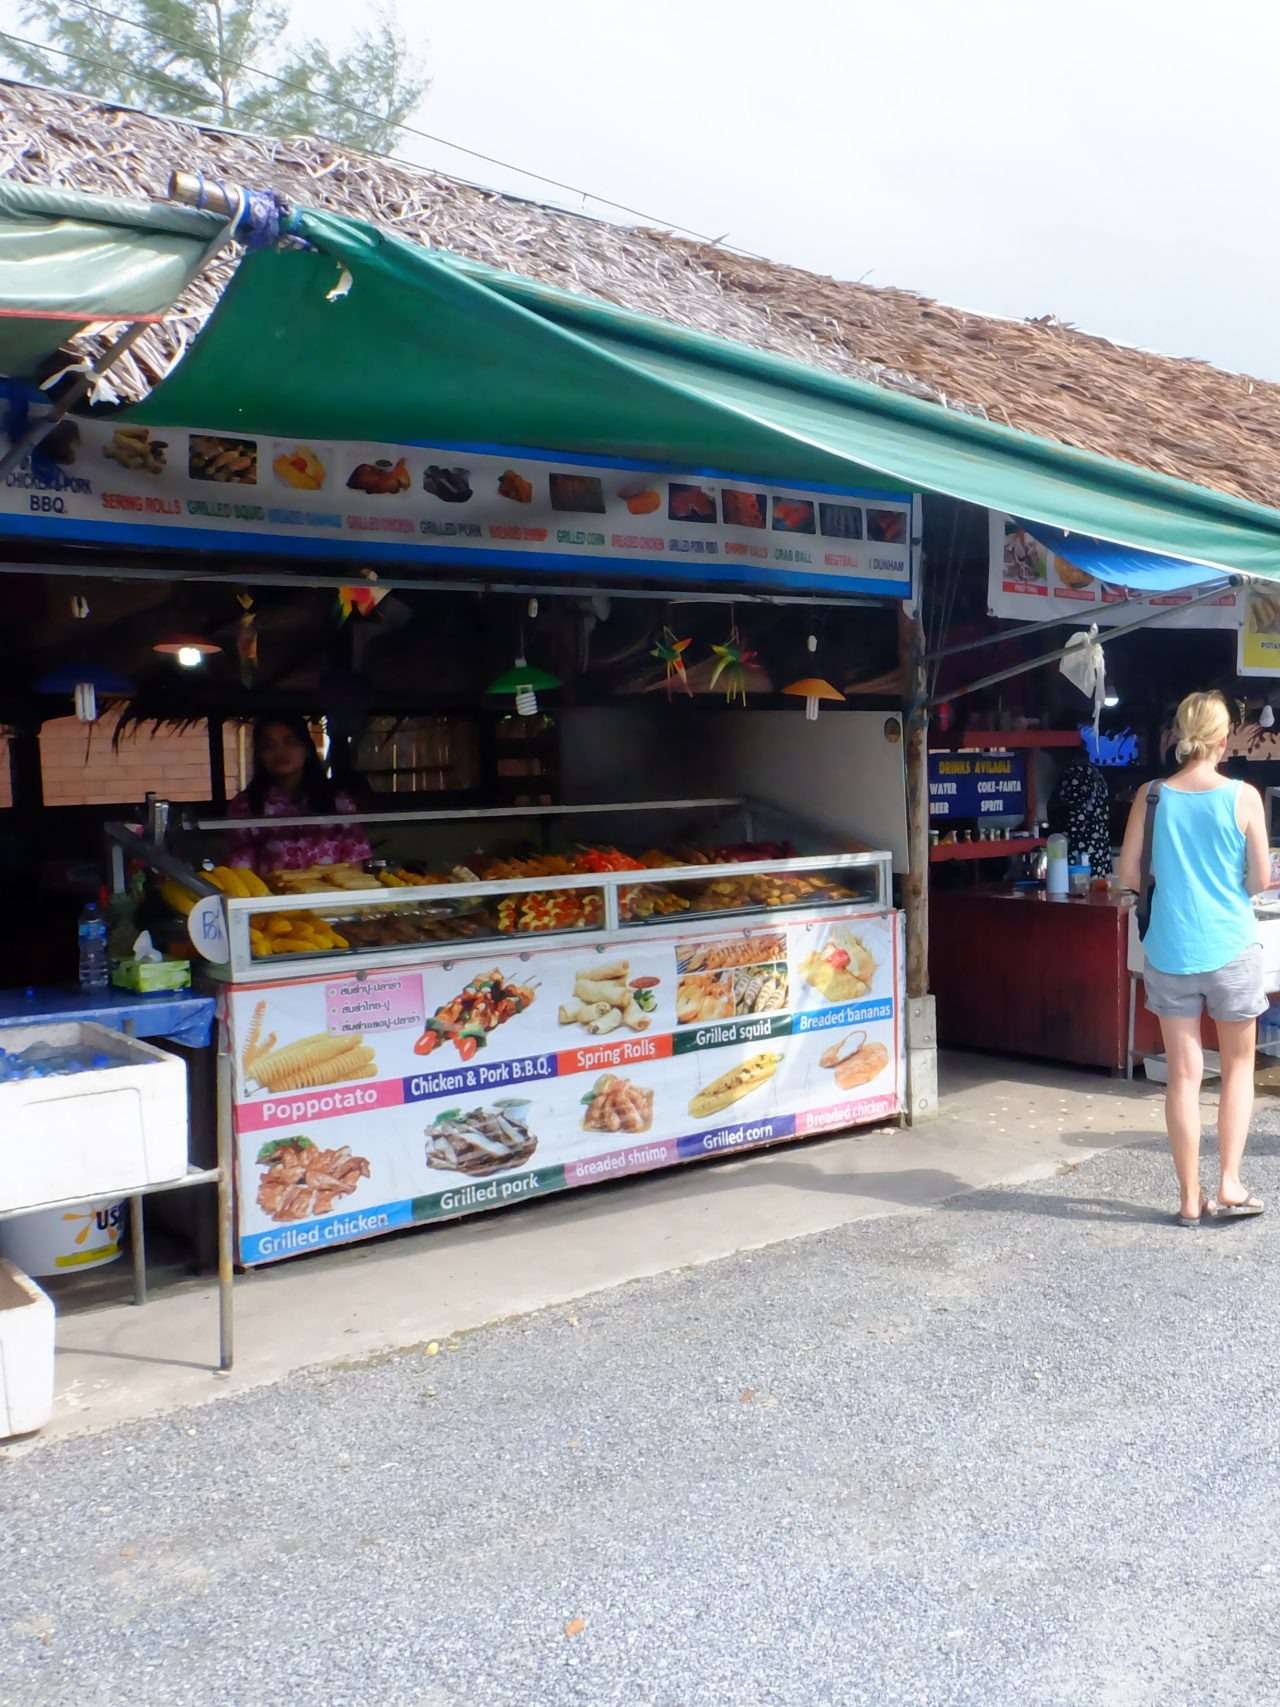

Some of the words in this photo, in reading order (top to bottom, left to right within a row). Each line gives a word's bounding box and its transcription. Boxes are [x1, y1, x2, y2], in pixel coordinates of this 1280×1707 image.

[929, 782, 957, 795] WATER
[977, 780, 1022, 793] COKE-FANTA
[929, 802, 949, 815] BEER
[980, 799, 1004, 813] SPRITE
[800, 1009, 845, 1030] Breaded
[847, 1003, 891, 1021] bananas
[696, 1027, 737, 1047] Grilled
[739, 1019, 772, 1045] squid
[576, 1046, 621, 1071] Spring
[624, 1039, 656, 1058] Rolls
[411, 1072, 464, 1097] Chicken
[466, 1071, 477, 1087] &
[479, 1063, 510, 1086] Pork
[512, 1055, 552, 1079] B.B.Q.
[262, 1086, 378, 1122] Poppotato
[806, 1107, 850, 1127] Breaded
[851, 1099, 889, 1119] chicken
[703, 1128, 744, 1150] Grilled
[745, 1124, 774, 1143] corn
[576, 1150, 625, 1178] Breaded
[627, 1144, 668, 1168] shrimp
[440, 1185, 498, 1211] Grilled
[501, 1173, 540, 1199] pork
[258, 1227, 321, 1257] Grilled
[324, 1212, 389, 1242] chicken
